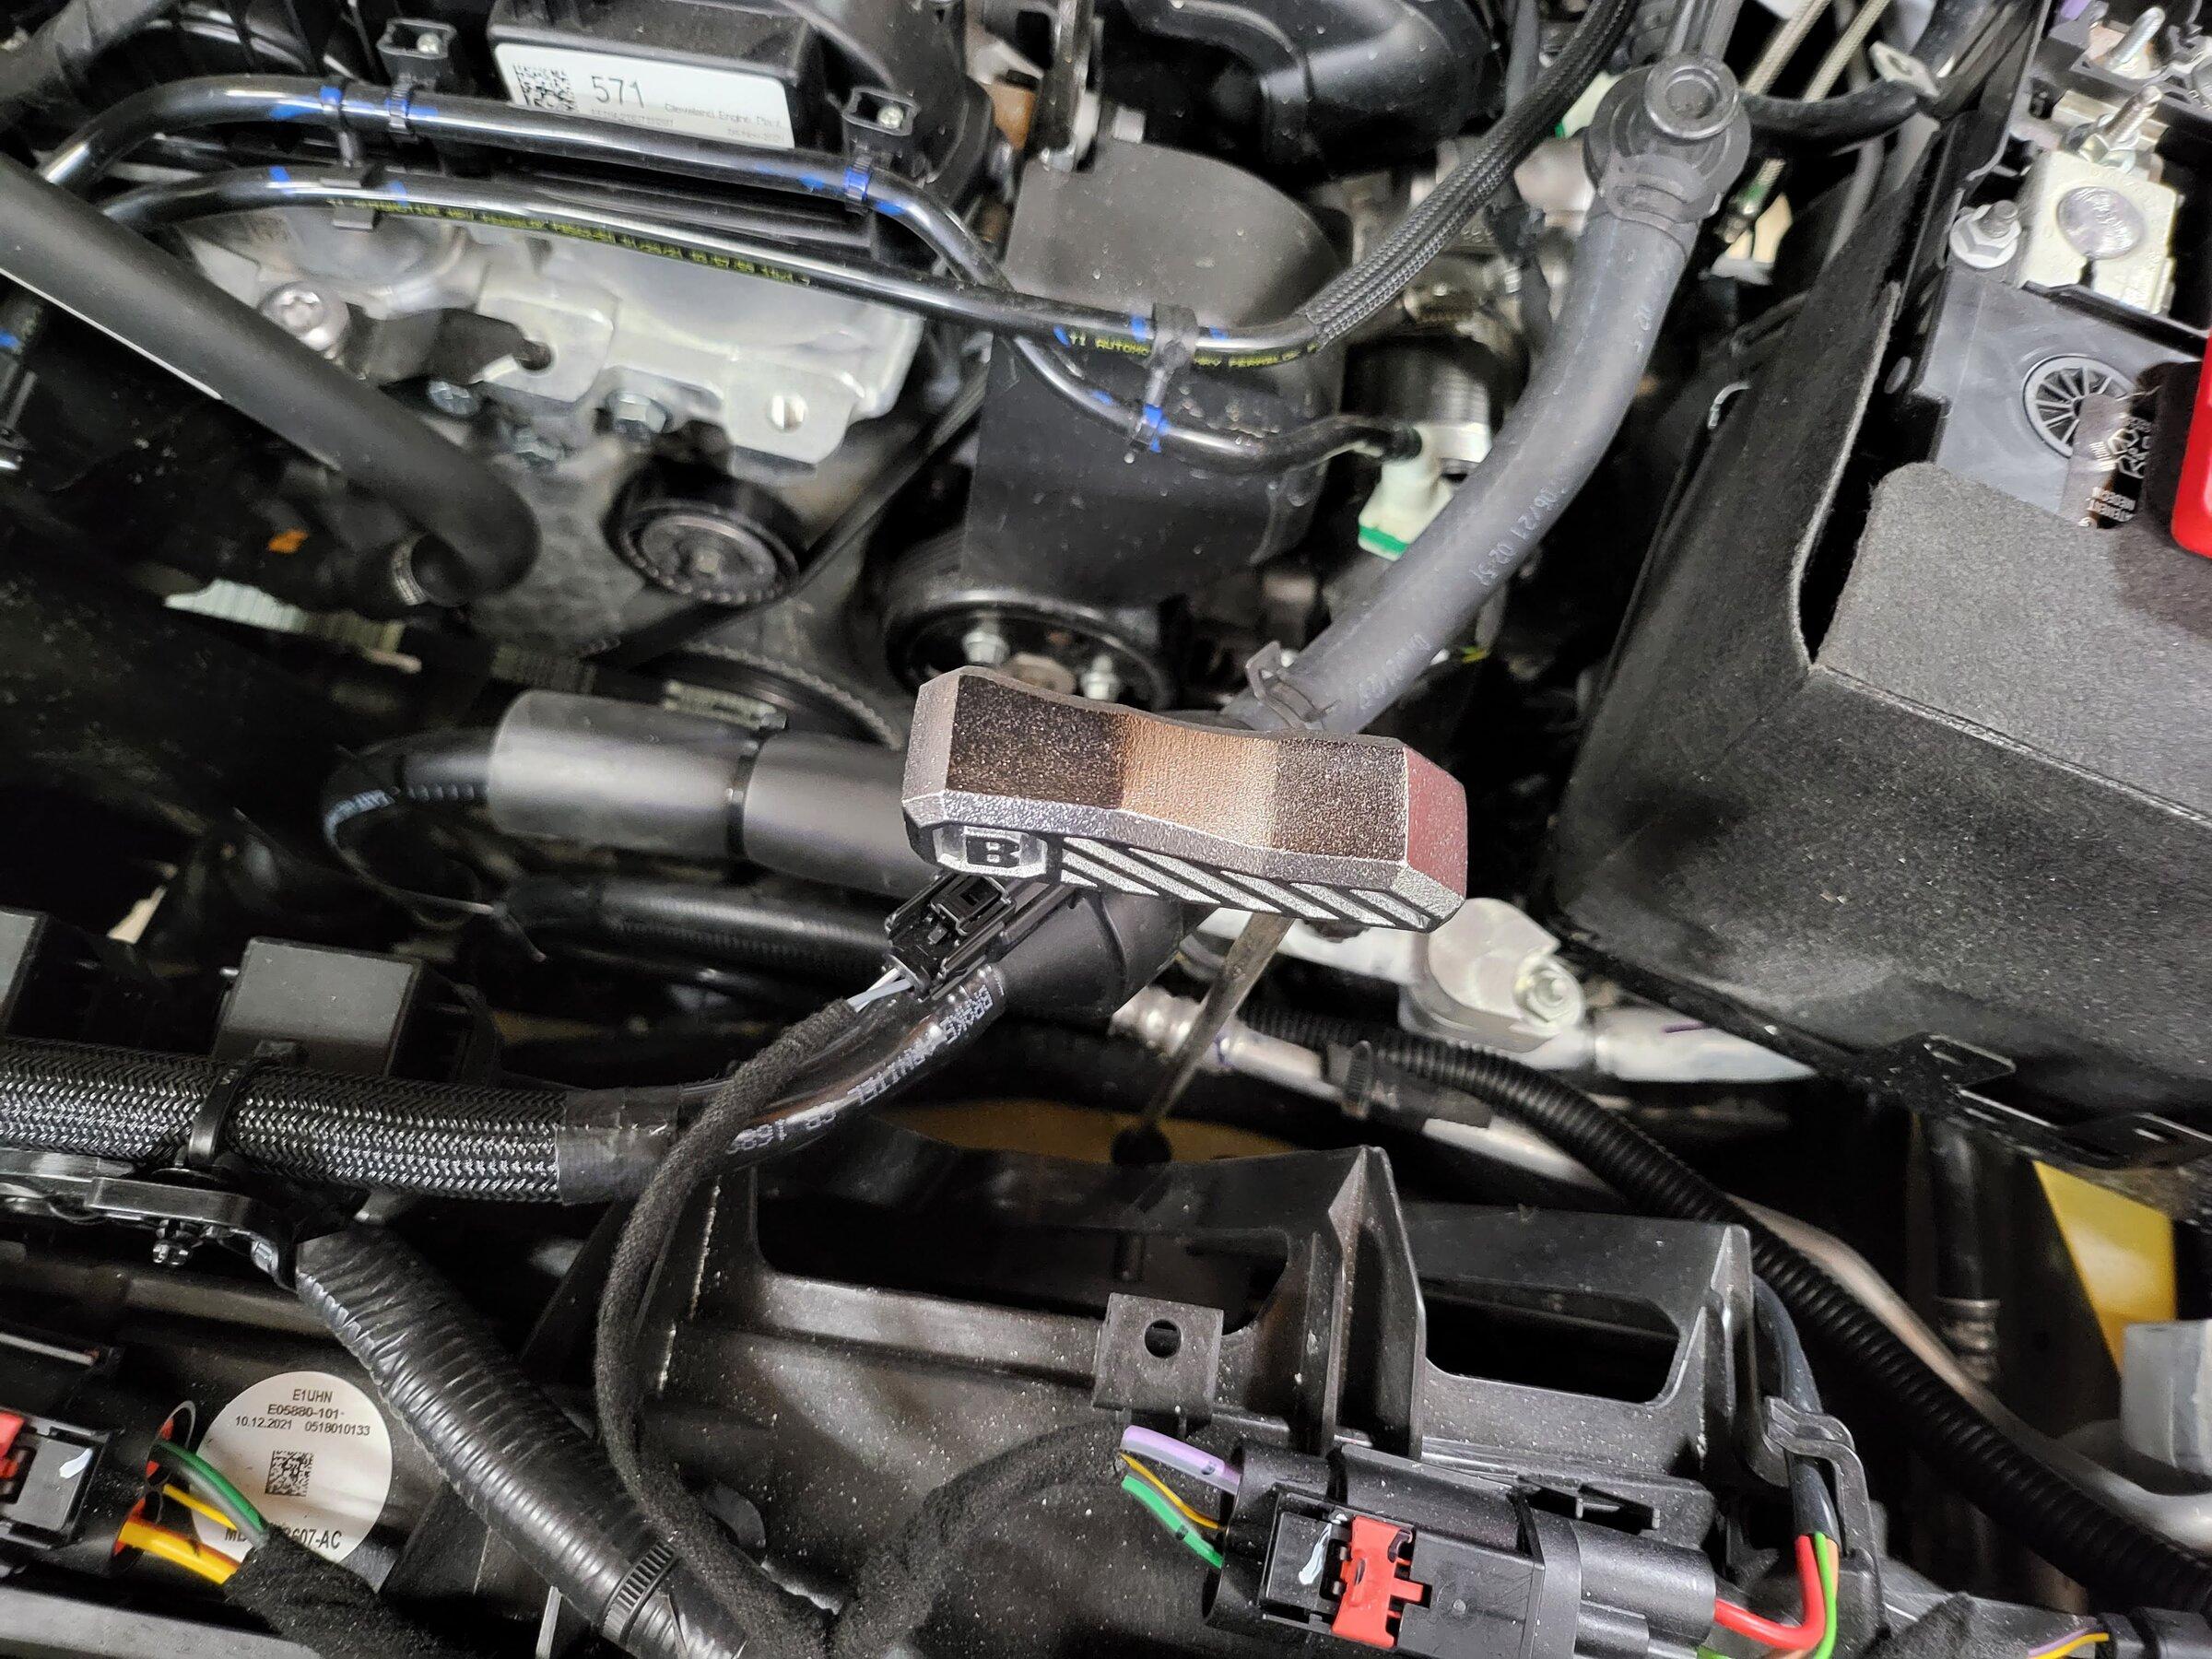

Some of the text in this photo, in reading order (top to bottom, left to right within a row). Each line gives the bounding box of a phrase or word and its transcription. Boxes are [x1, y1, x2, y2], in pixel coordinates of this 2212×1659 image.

[590, 75, 645, 109] 571
[965, 836, 1020, 868] B
[939, 984, 994, 1045] BRAKE
[292, 1388, 334, 1404] E1UHN
[235, 1416, 371, 1436] 10.12.2021 0518010133
